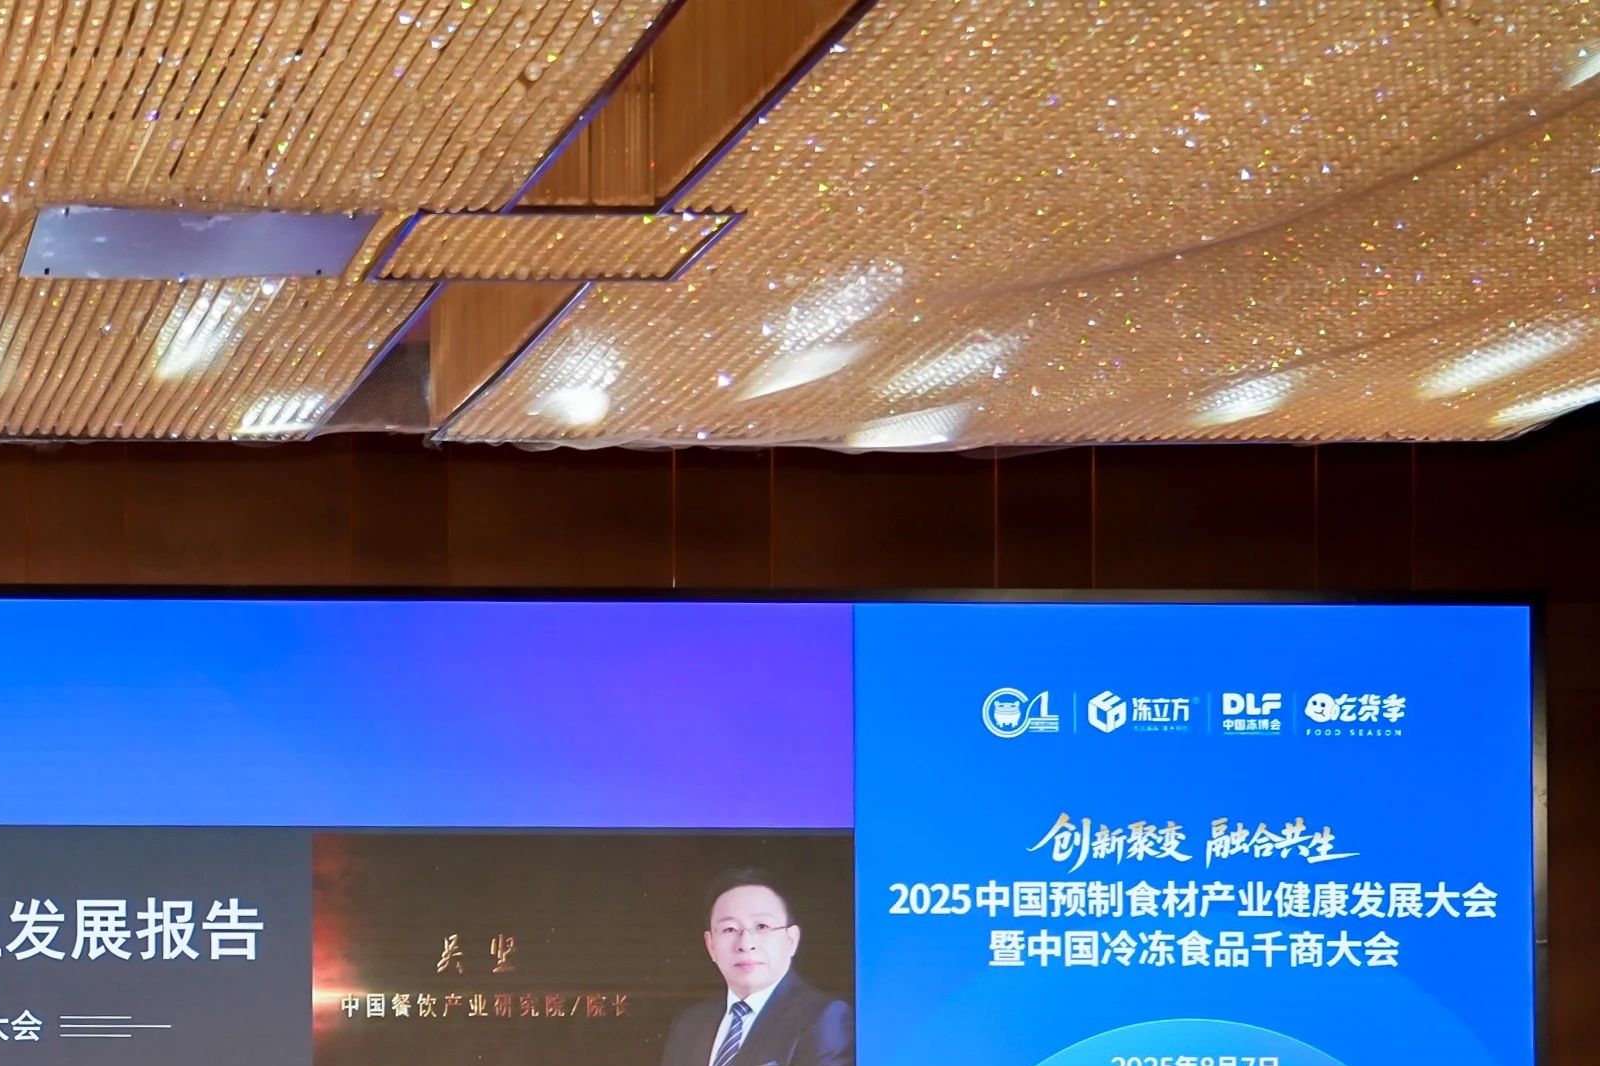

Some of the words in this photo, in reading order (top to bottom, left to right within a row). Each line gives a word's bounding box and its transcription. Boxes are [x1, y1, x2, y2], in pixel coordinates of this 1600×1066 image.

[1131, 697, 1190, 722] 冻立方
[1222, 692, 1282, 716] DLF
[1305, 728, 1342, 736] FOOD
[1349, 728, 1402, 737] SEASON
[1025, 812, 1193, 873] 创新聚变
[1204, 817, 1361, 868] 融合共生
[888, 879, 1498, 920] 2025中国预制食材产业健康发展大会
[988, 928, 1400, 968] 暨中国冷冻食品千商大会
